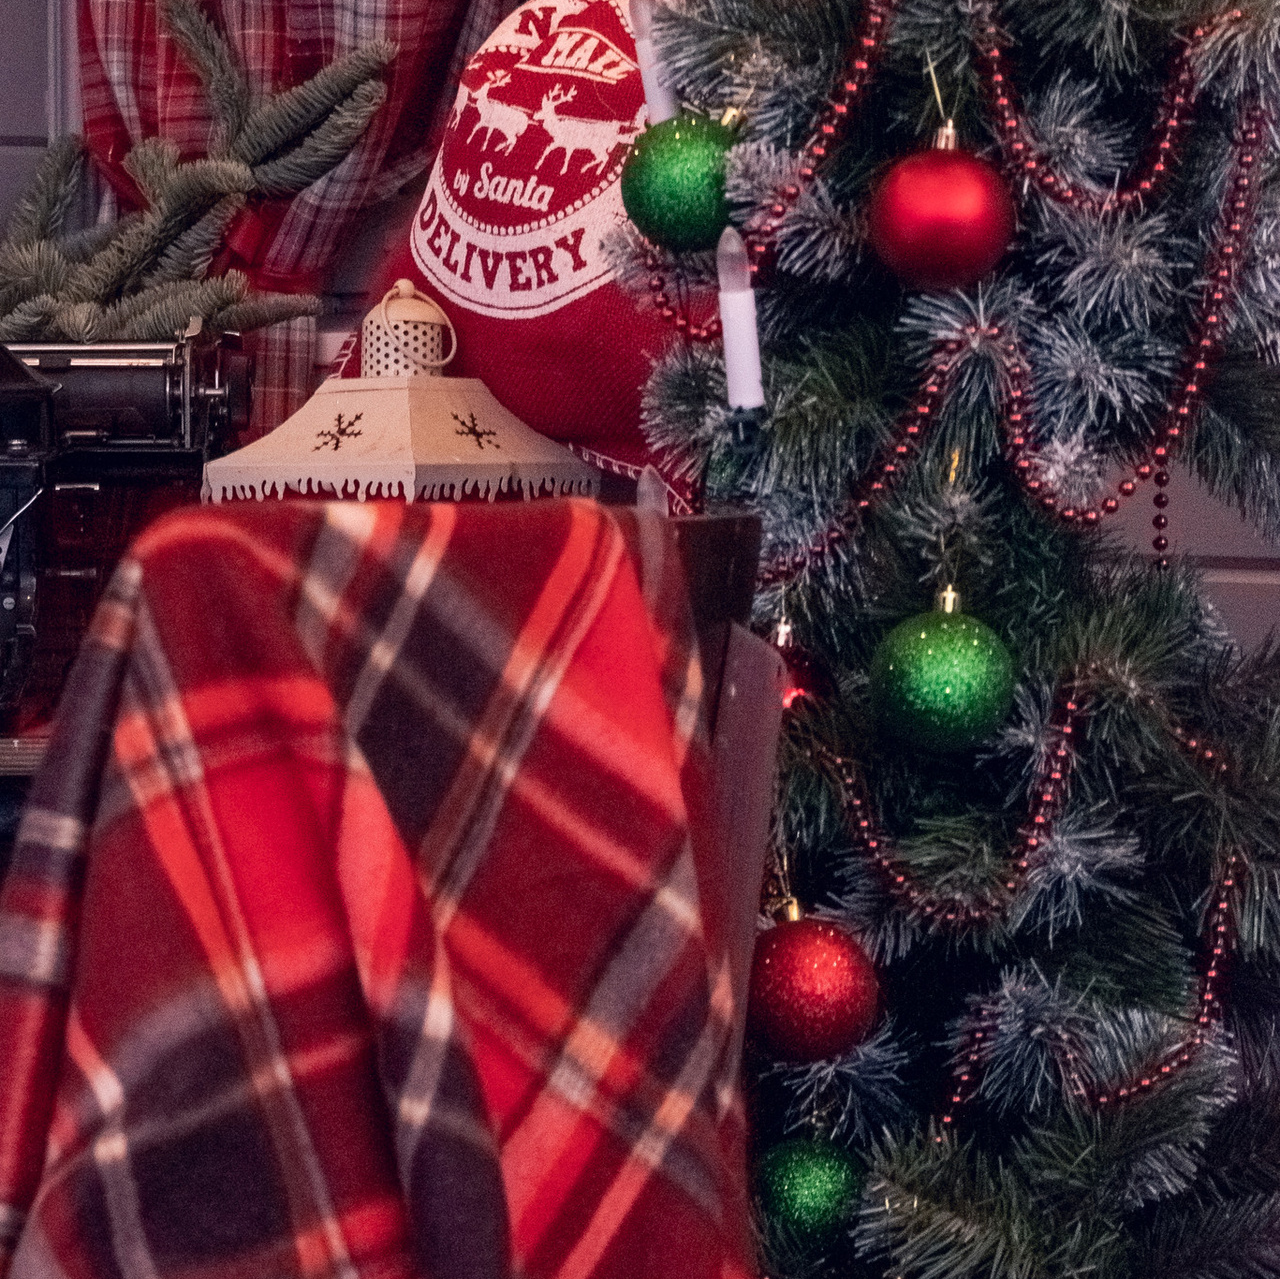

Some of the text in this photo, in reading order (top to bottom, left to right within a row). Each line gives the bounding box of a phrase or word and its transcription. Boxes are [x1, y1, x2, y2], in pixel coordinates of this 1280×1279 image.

[453, 162, 555, 212] by Santa
[421, 187, 588, 292] DELIVERY
